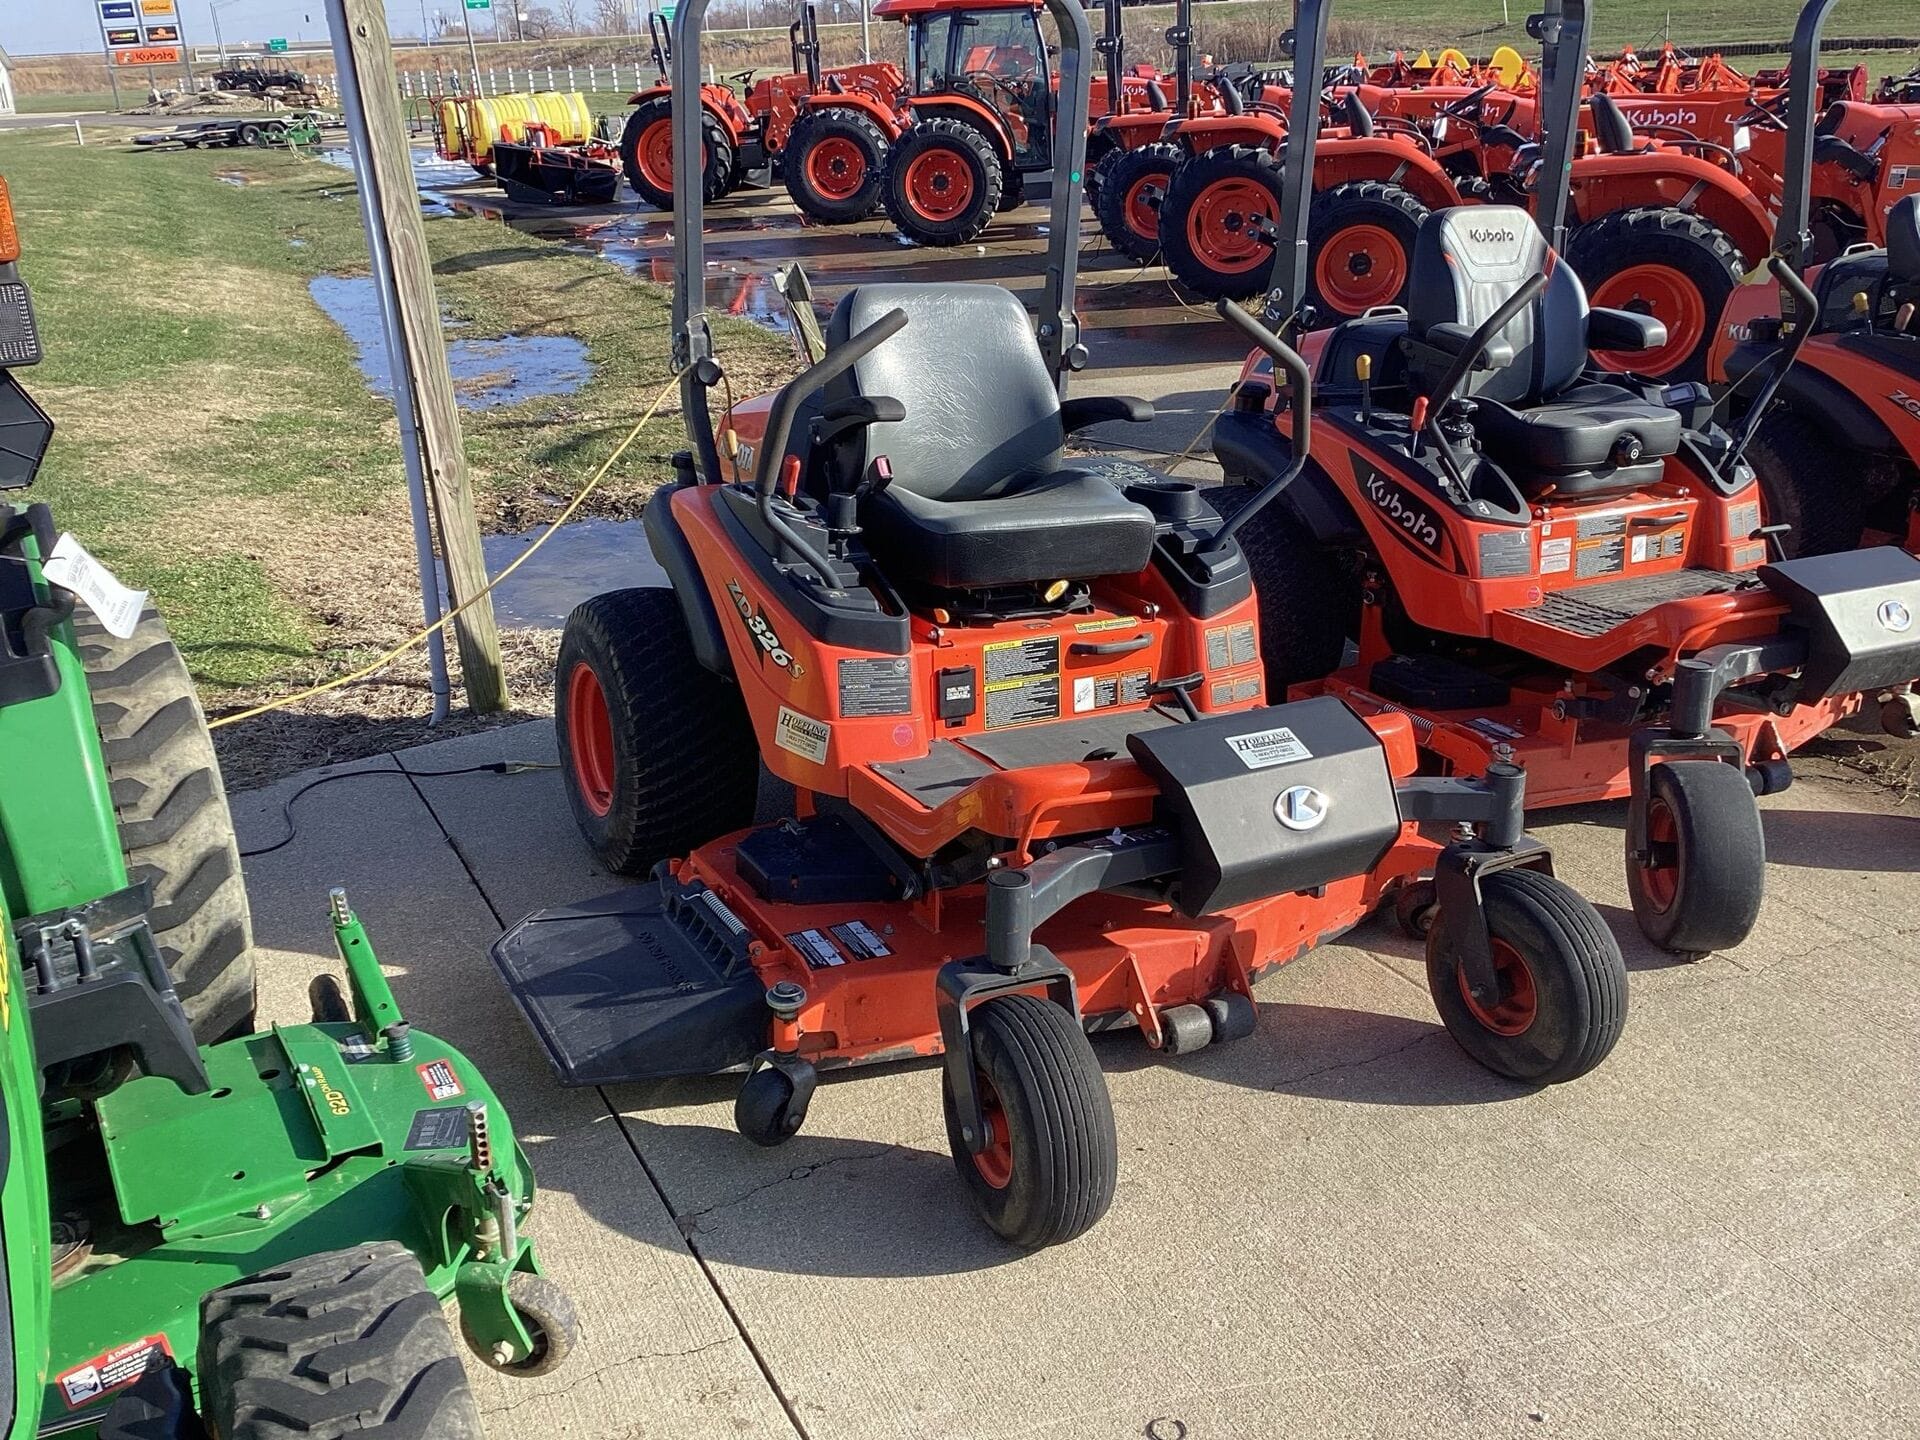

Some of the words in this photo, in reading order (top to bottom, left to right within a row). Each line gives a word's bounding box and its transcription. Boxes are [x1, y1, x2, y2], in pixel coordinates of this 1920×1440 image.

[135, 52, 175, 61] Kubota
[1626, 108, 1697, 127] Kubota
[1469, 228, 1515, 243] Kubota
[1888, 389, 1920, 418] ZG
[1366, 472, 1437, 546] Kubota
[1236, 731, 1290, 751] HOEFLING
[325, 1088, 351, 1115] 62D
[114, 1339, 148, 1358] DANGER
